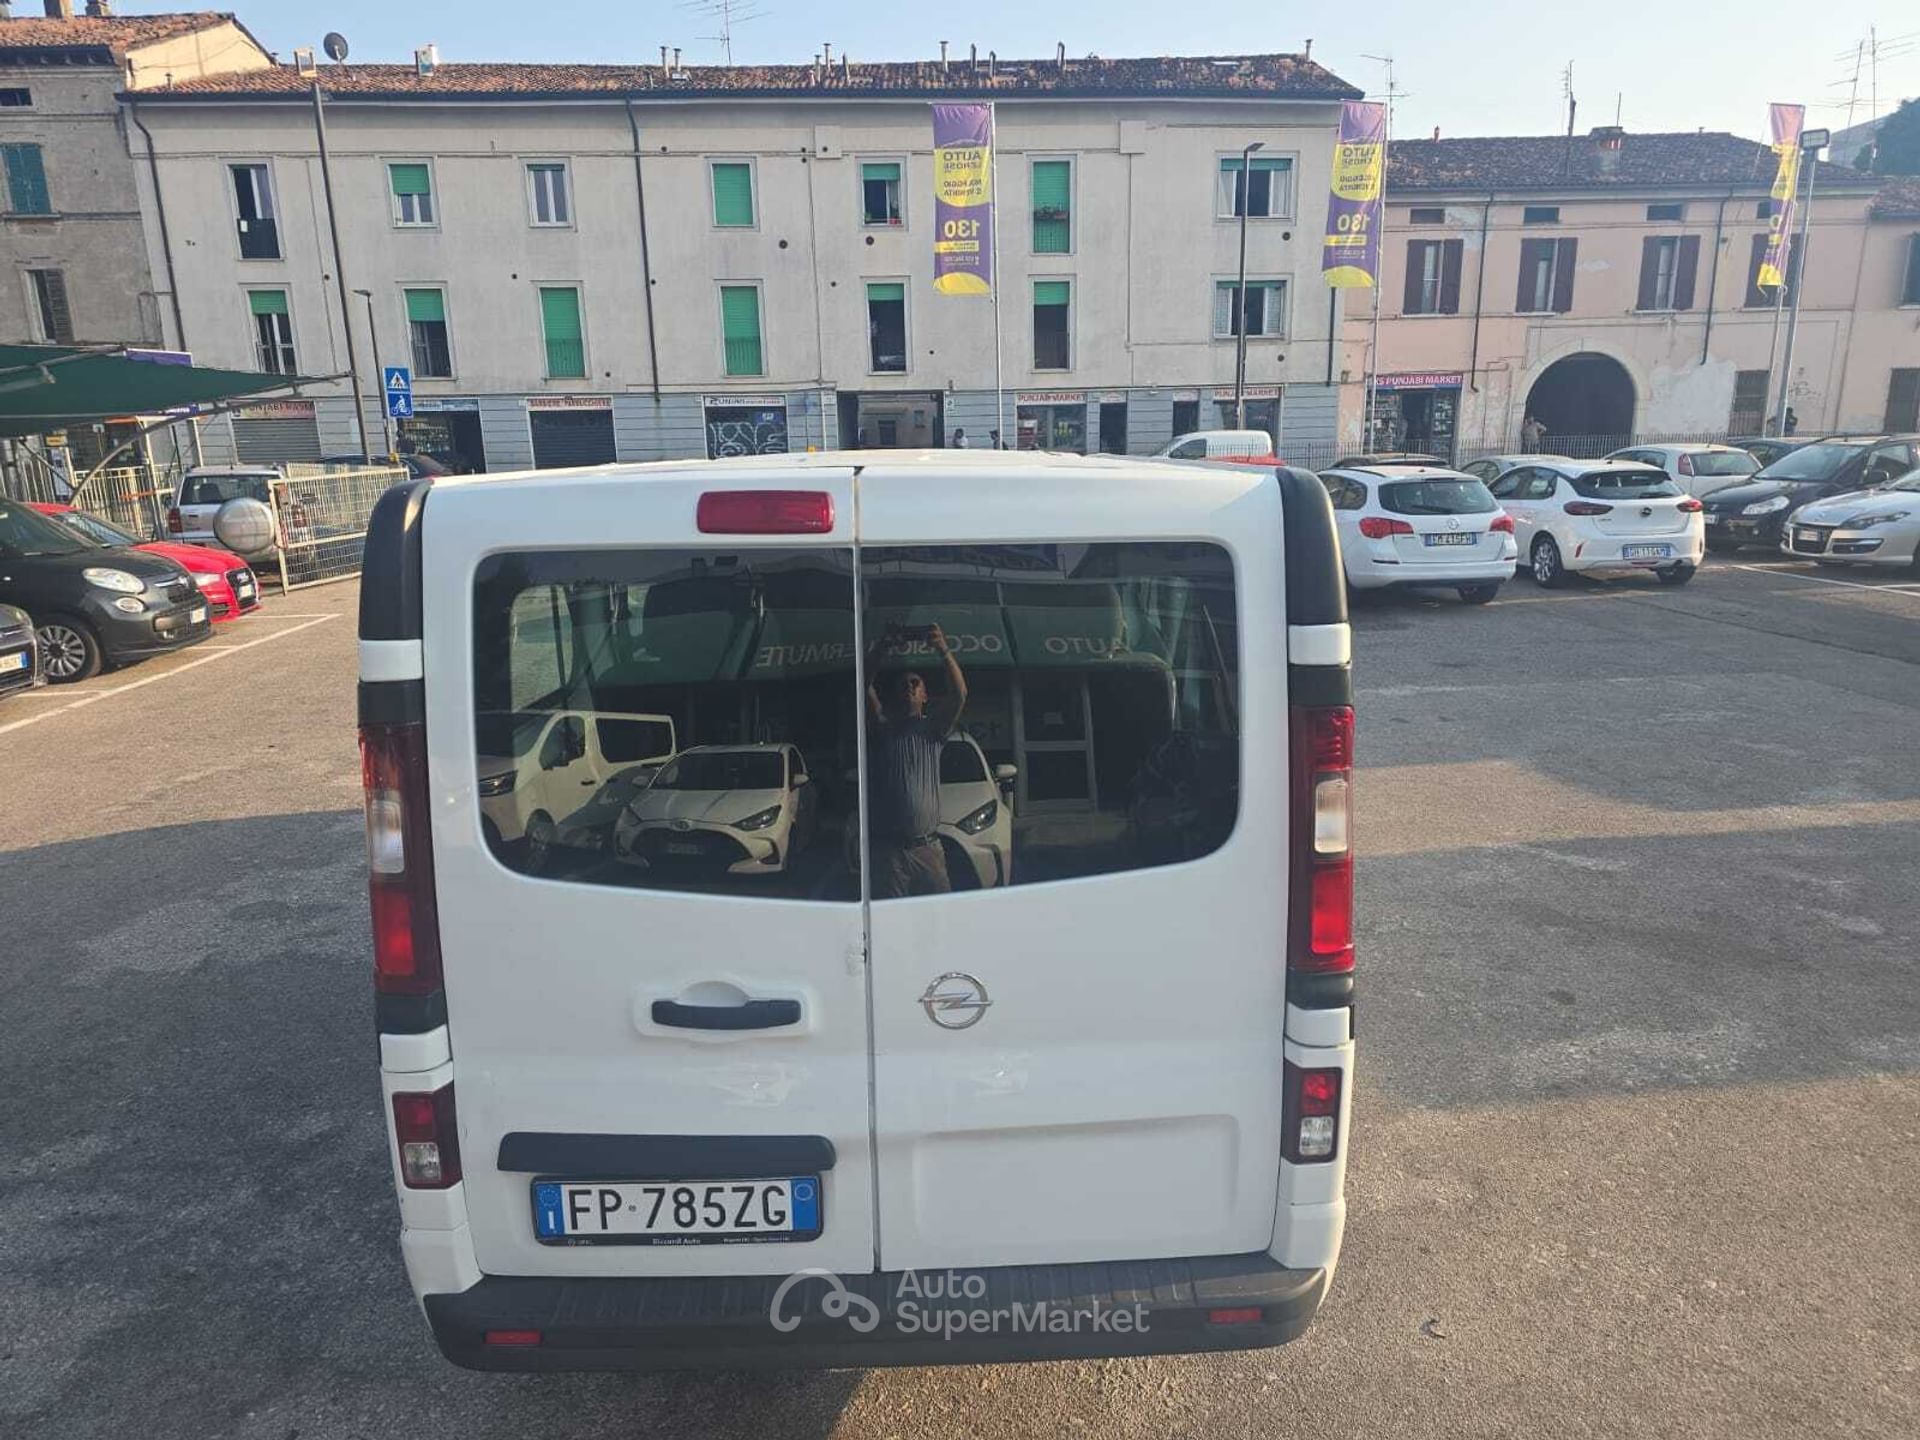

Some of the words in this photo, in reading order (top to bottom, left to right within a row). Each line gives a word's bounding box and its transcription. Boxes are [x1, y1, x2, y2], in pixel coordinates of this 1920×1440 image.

[1385, 375, 1424, 385] PUNJABI
[1425, 374, 1462, 385] MARKET
[1055, 392, 1086, 401] MARKET
[568, 1188, 622, 1230] FP
[643, 1185, 786, 1229] 785ZG
